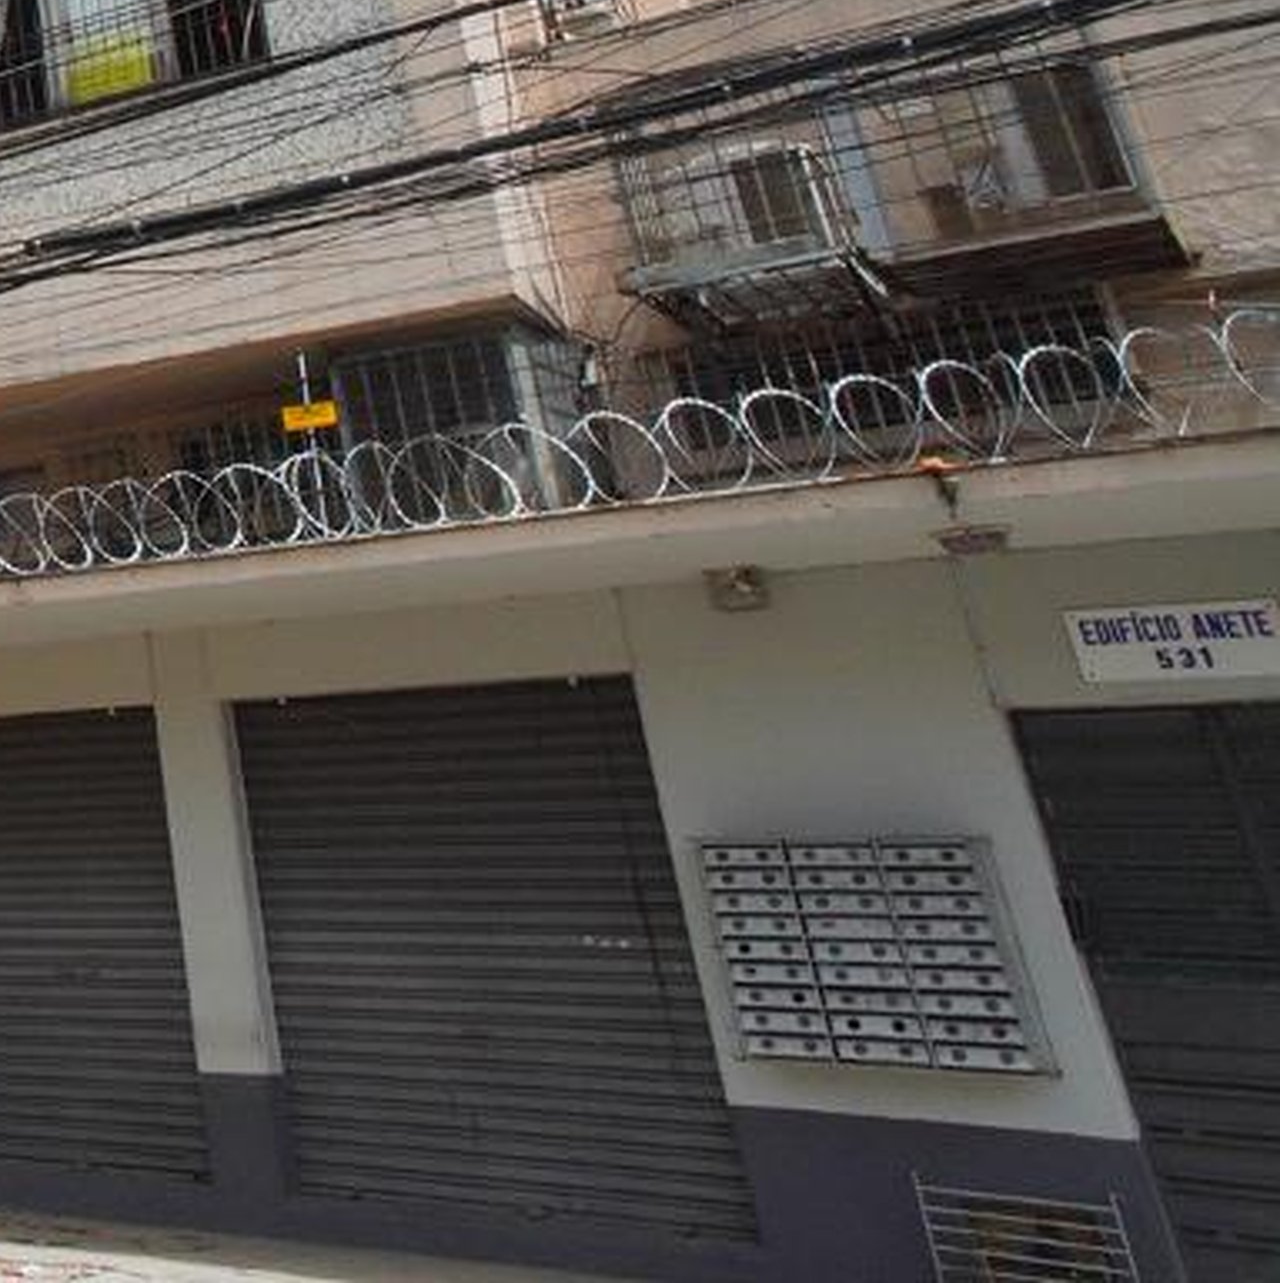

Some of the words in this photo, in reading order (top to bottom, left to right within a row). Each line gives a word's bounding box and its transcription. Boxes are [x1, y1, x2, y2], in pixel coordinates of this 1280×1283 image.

[1078, 611, 1182, 646] EDIFÍCIO
[1192, 610, 1275, 639] ANETE
[1156, 647, 1214, 669] 531
